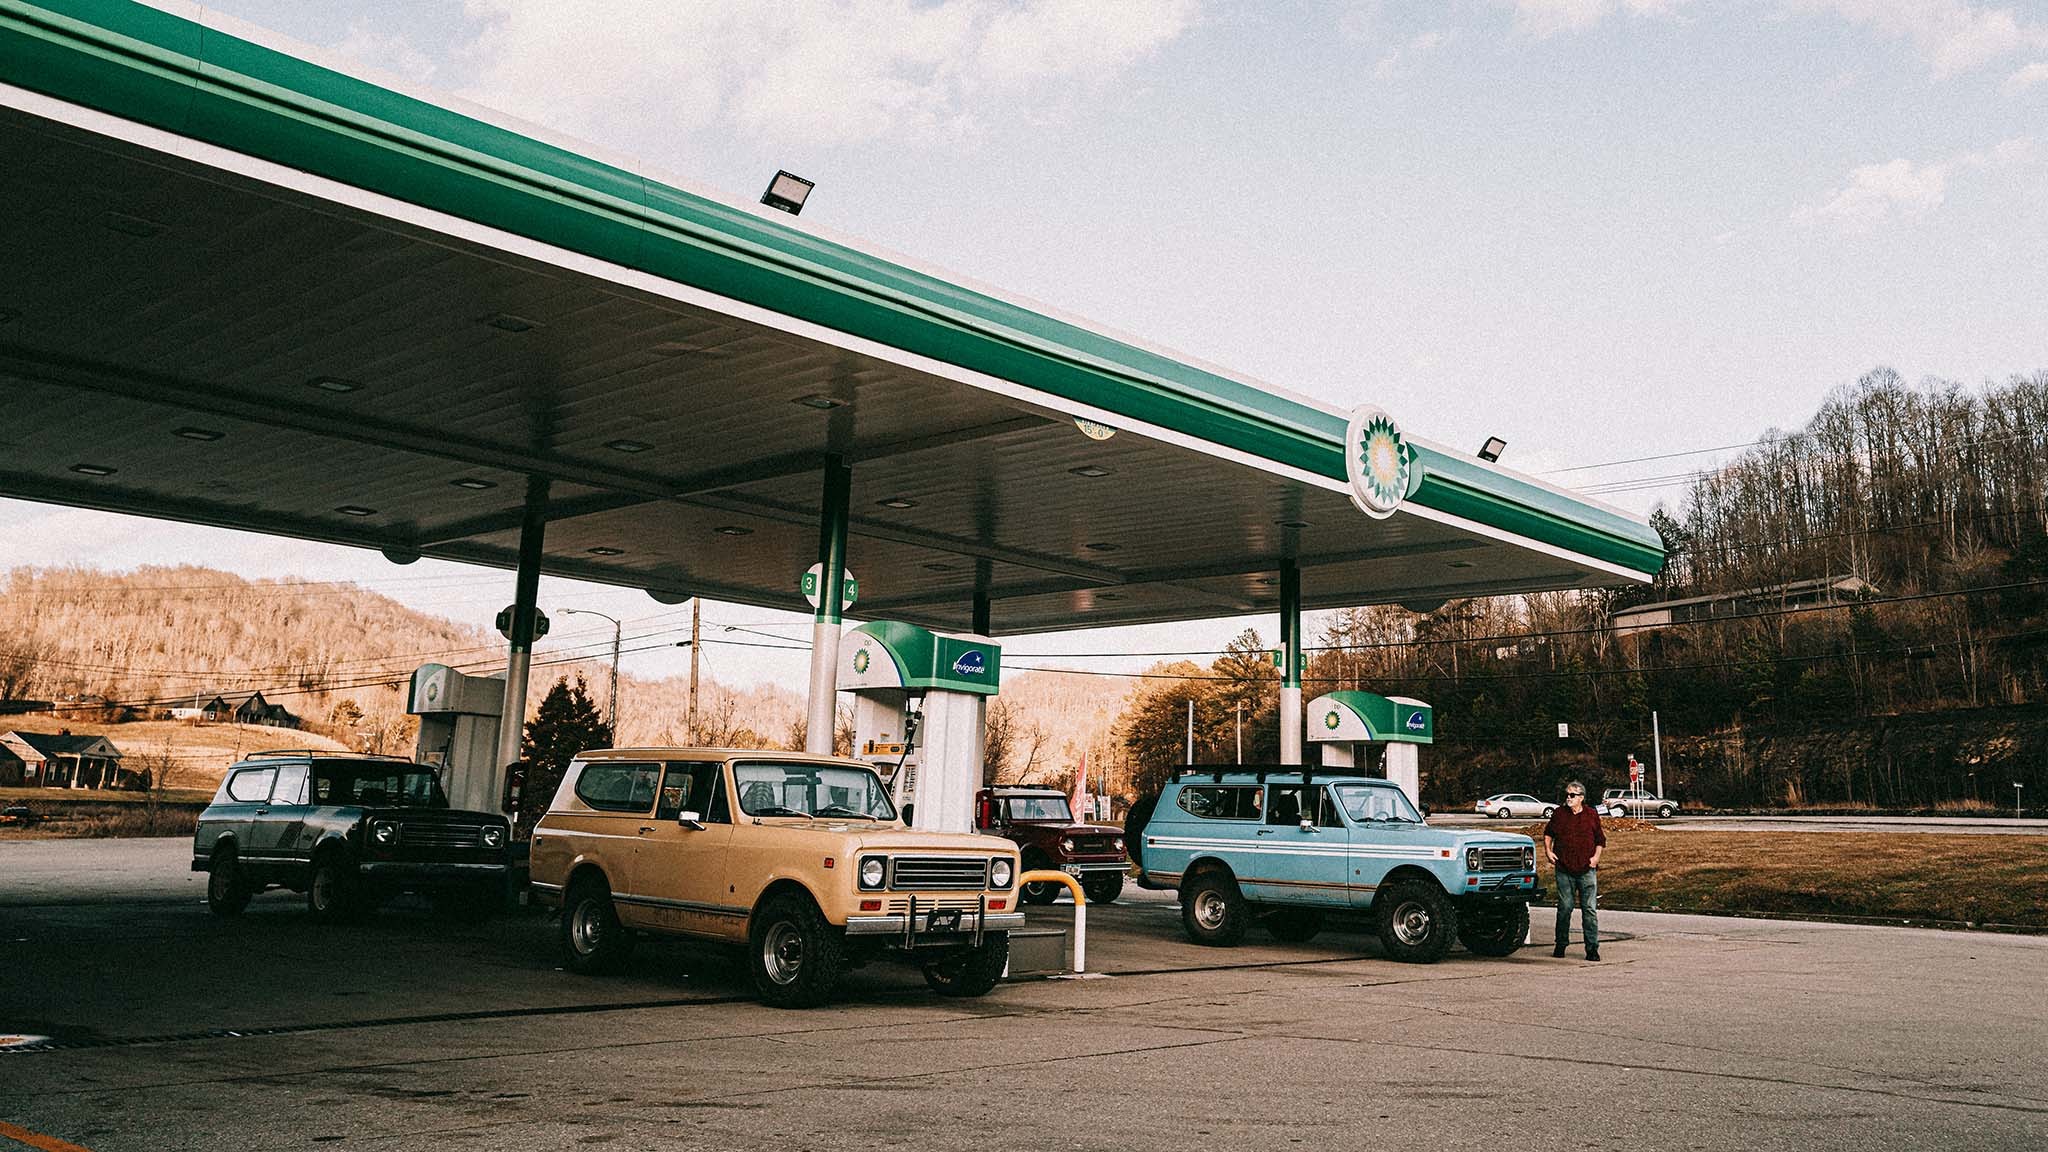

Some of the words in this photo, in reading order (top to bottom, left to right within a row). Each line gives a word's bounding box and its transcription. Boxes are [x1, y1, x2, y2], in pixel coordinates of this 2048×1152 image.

[806, 576, 812, 590] 3
[848, 584, 854, 596] 4
[540, 620, 546, 630] 2
[1276, 654, 1280, 663] 7
[952, 662, 984, 674] Invigorate
